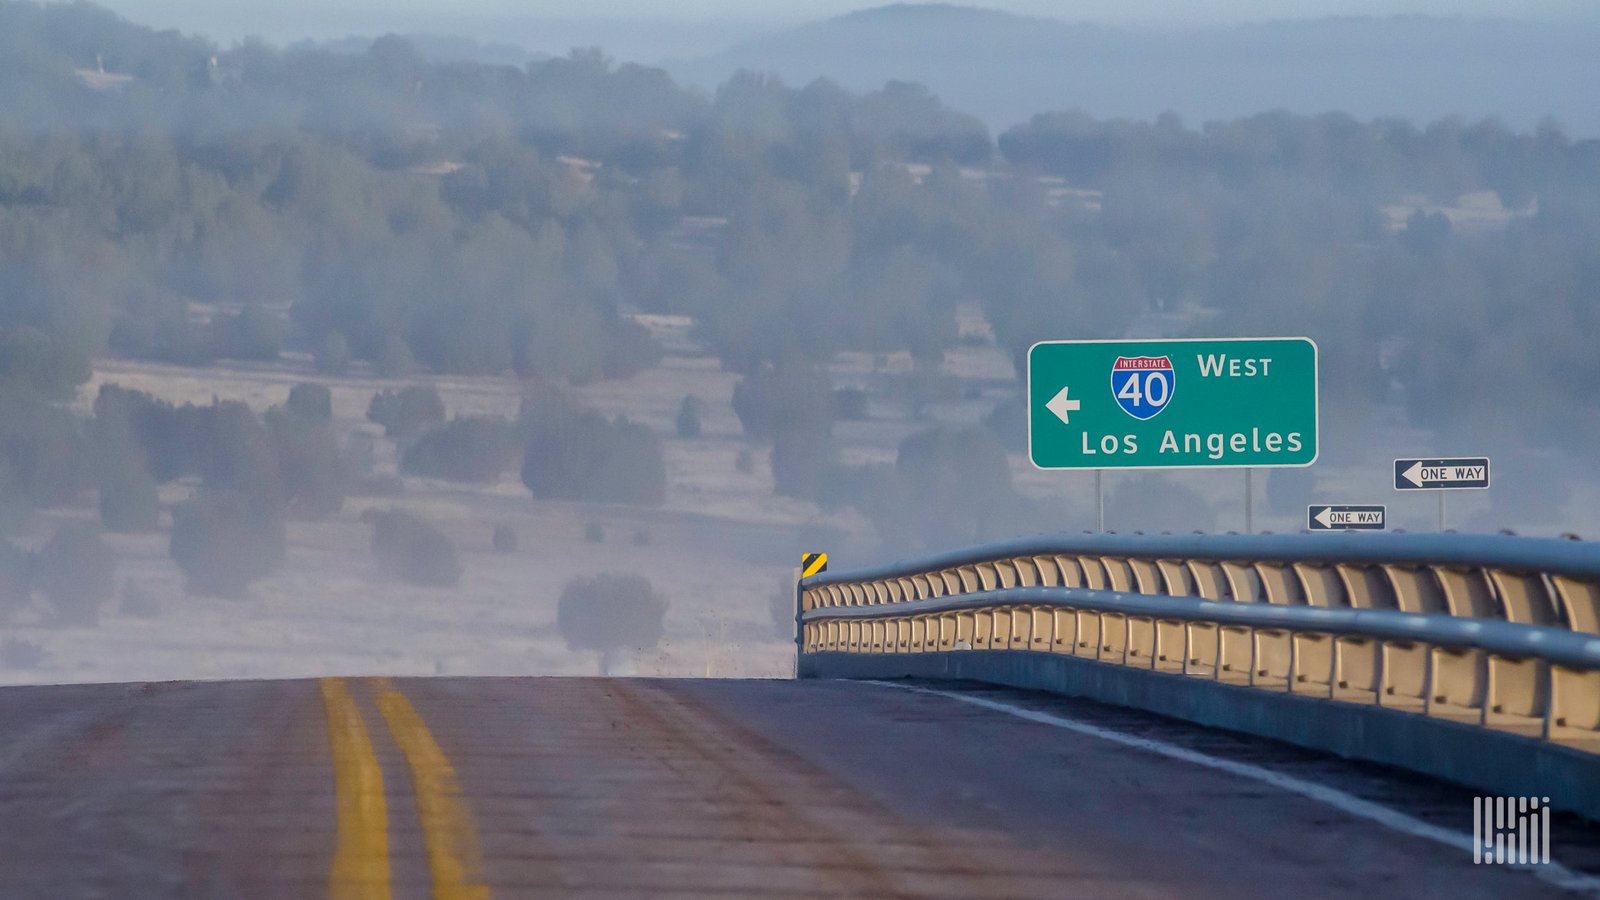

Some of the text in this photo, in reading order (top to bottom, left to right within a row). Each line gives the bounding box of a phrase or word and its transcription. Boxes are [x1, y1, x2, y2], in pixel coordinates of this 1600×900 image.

[1120, 359, 1166, 368] INTERSTATE
[1197, 353, 1272, 377] WEST
[1118, 372, 1168, 407] 40
[1082, 427, 1302, 459] Los Angeles
[1421, 467, 1482, 480] ONE WAY
[1330, 512, 1380, 523] ONE WAY
